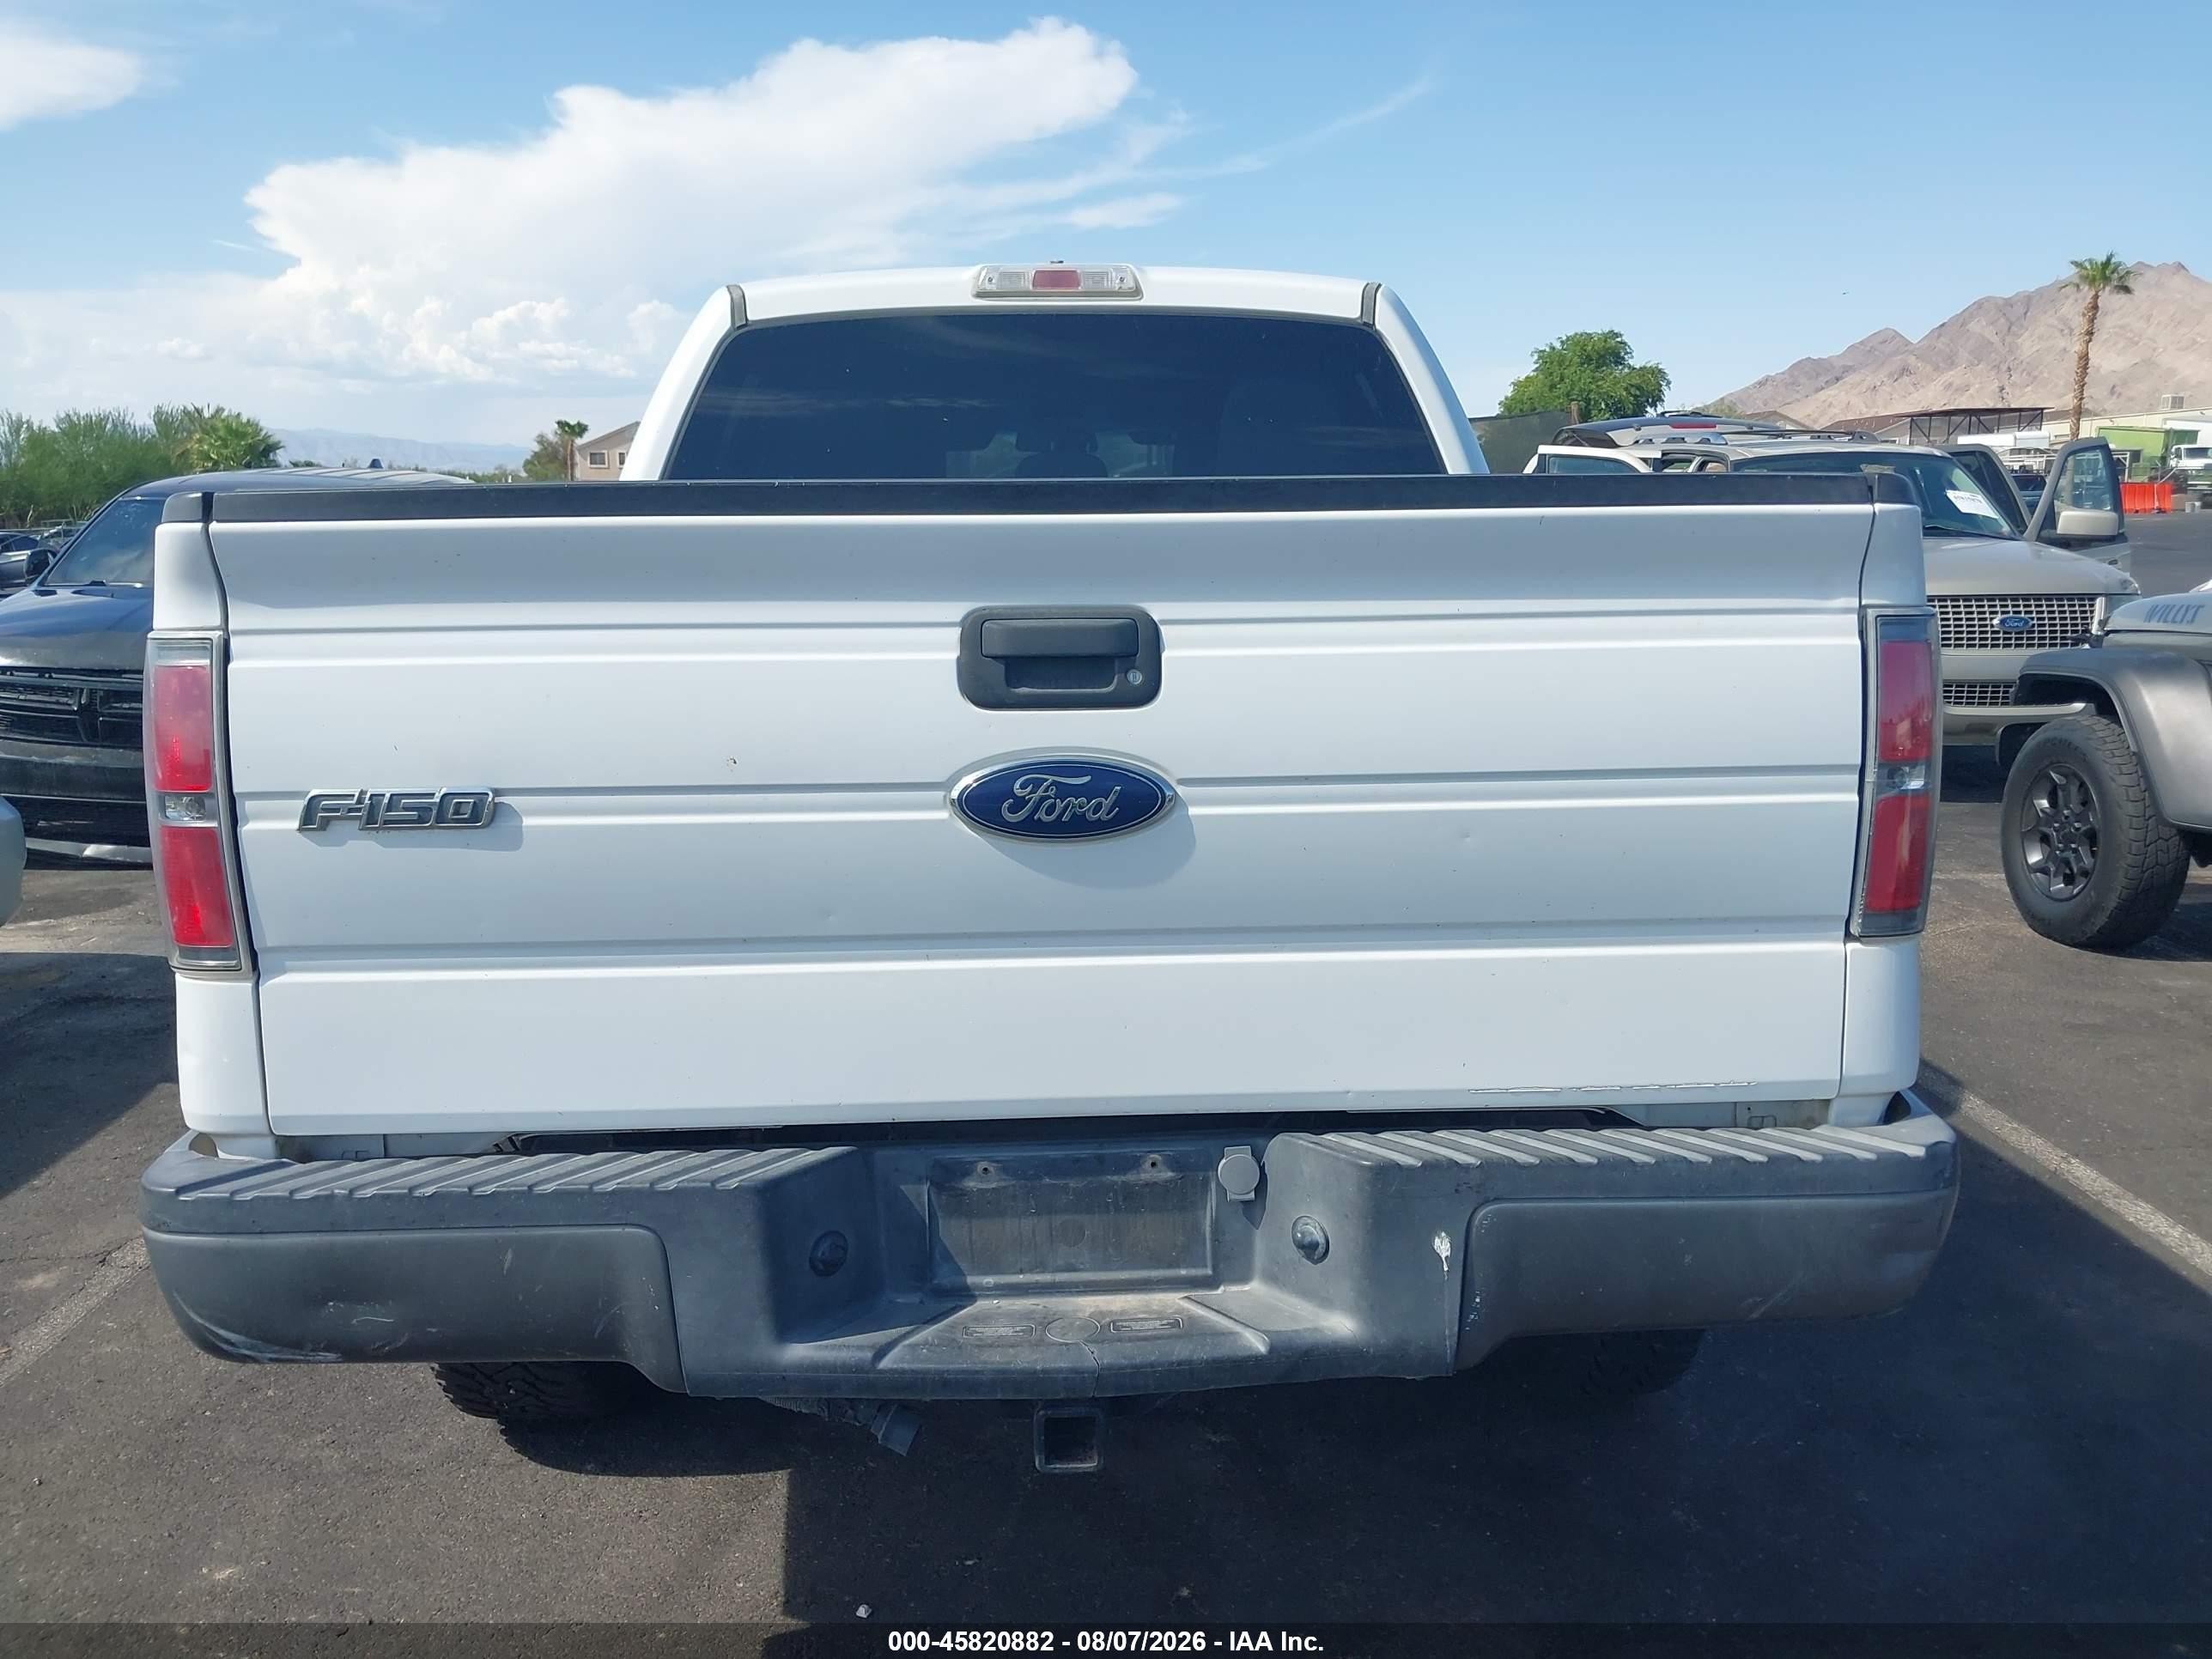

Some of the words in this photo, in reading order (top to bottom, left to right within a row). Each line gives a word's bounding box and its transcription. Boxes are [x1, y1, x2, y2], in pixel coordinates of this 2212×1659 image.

[2004, 617, 2025, 627] Ford
[297, 787, 496, 831] F-150
[1001, 774, 1120, 823] Ford
